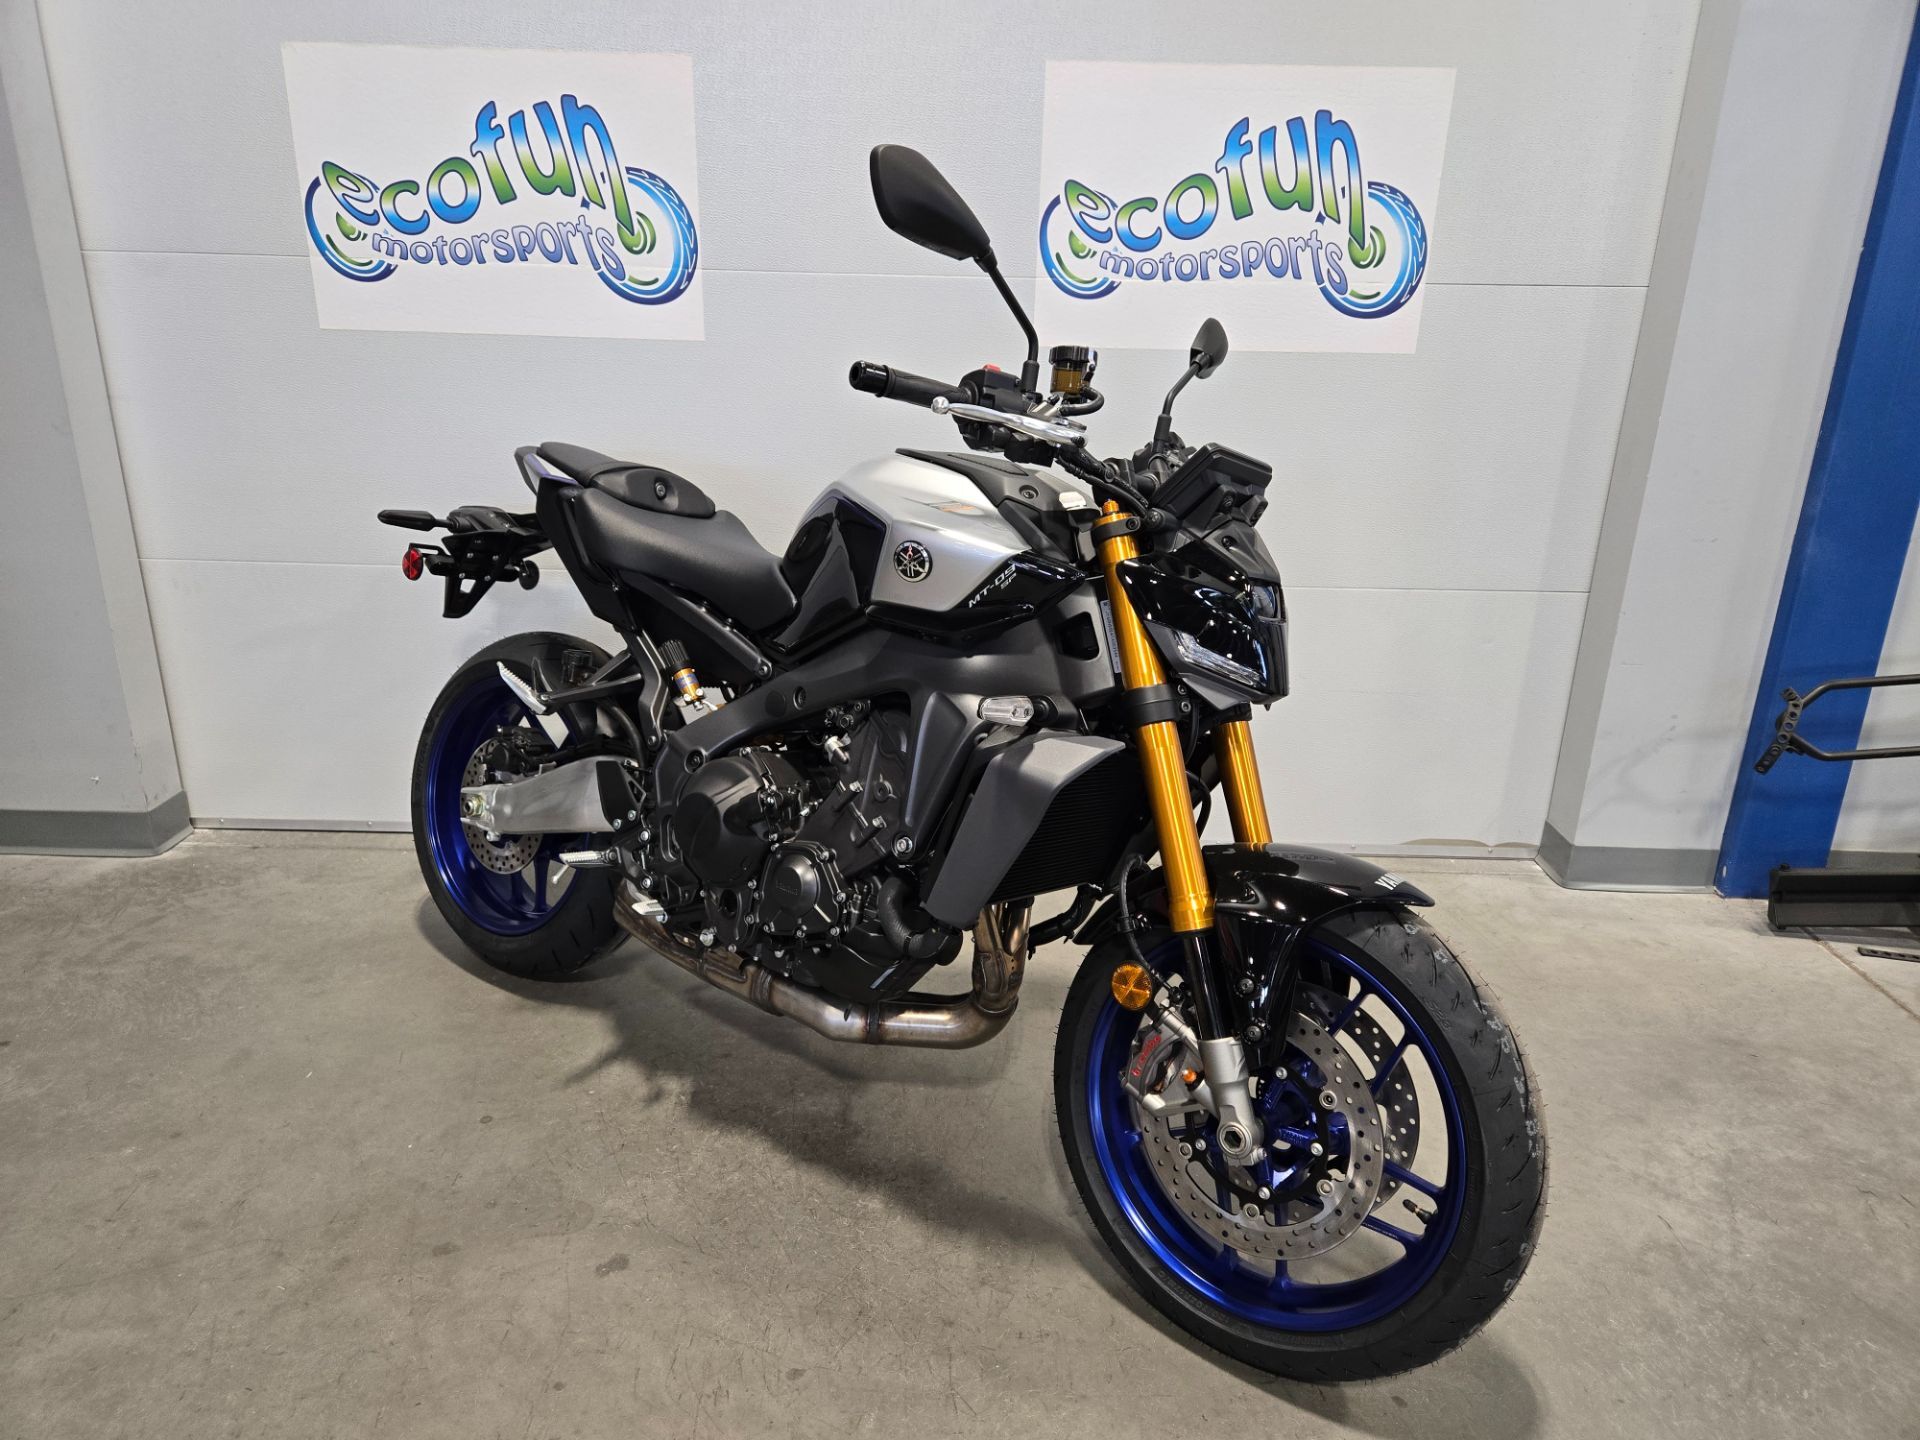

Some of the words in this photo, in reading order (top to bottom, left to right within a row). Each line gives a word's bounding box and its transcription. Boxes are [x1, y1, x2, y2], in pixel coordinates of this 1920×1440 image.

[322, 94, 636, 236] ecofun
[1064, 110, 1365, 252] ecofun
[372, 215, 626, 282] motorsports
[1100, 230, 1348, 295] motorsports
[968, 563, 1016, 608] MT-09
[1000, 573, 1017, 589] SP
